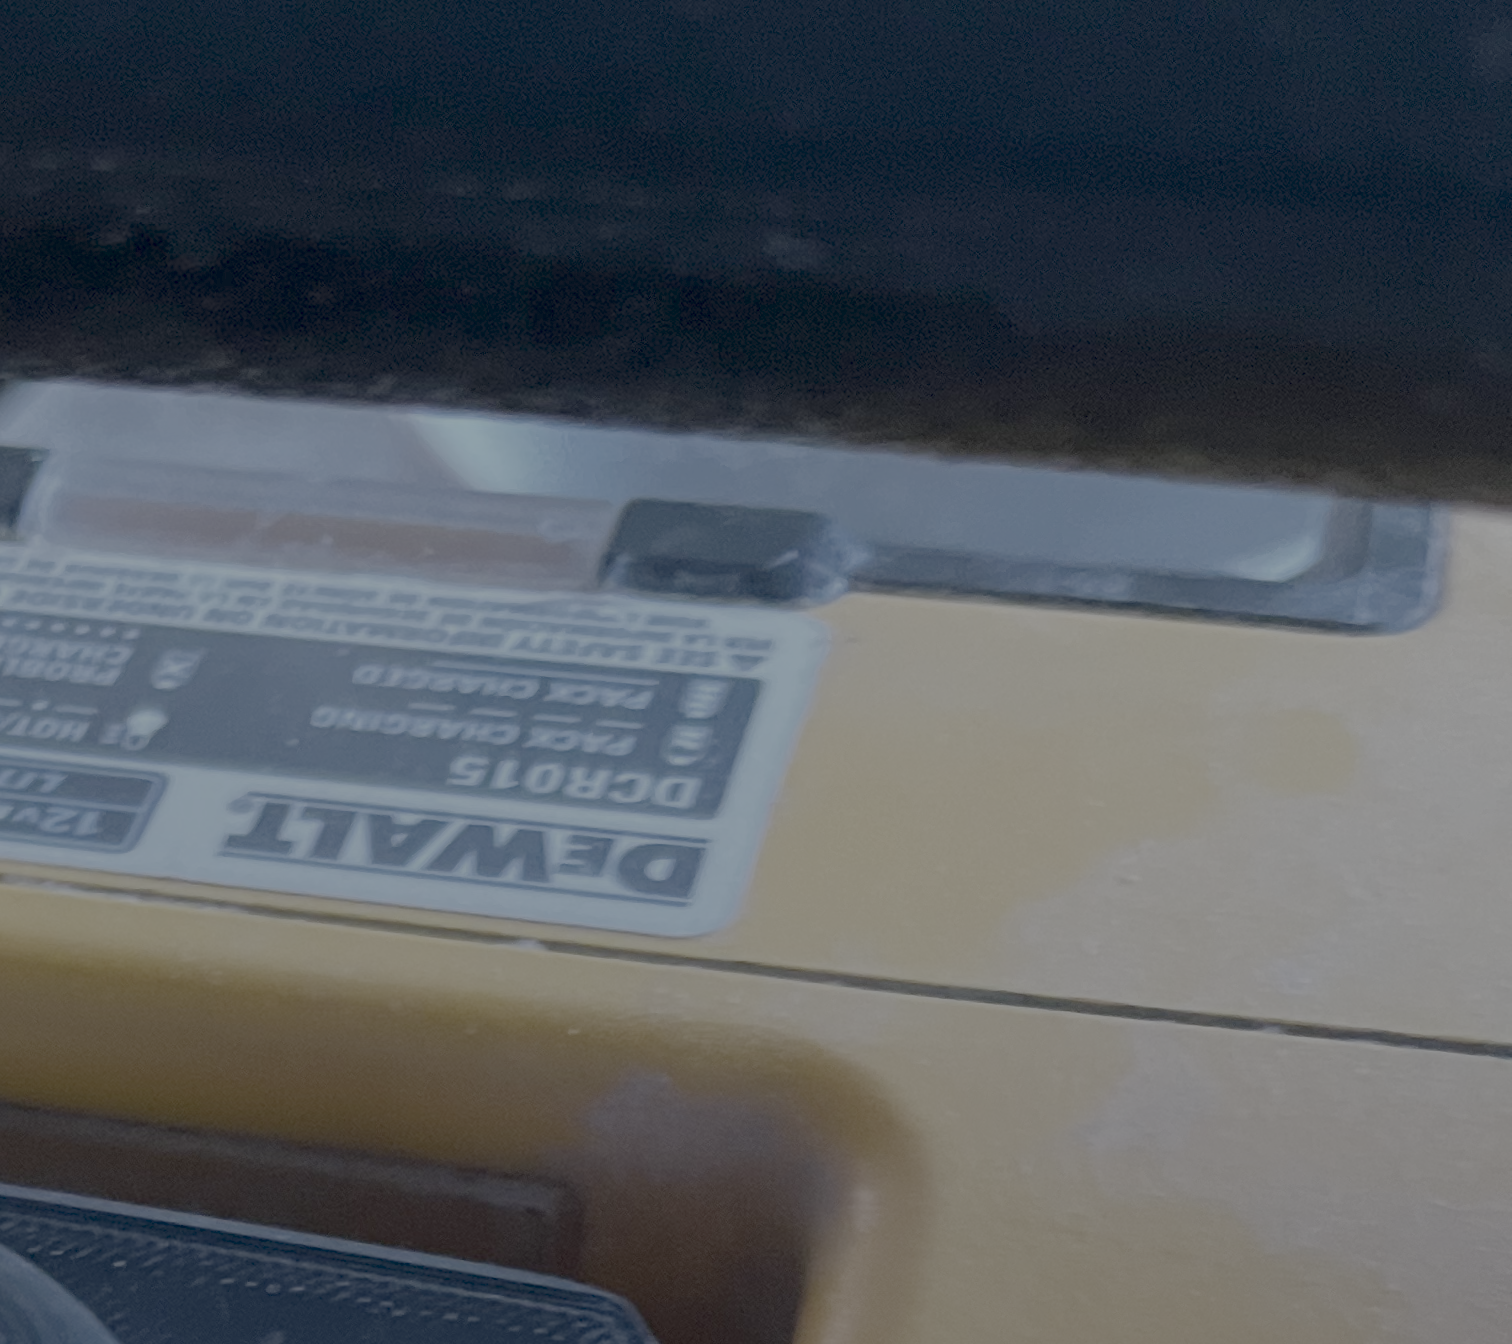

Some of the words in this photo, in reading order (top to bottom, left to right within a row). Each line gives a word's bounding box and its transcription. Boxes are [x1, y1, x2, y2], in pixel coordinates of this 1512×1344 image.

[351, 663, 539, 699] CHARGED
[543, 681, 654, 709] PACK
[310, 704, 520, 744] CHARGING
[522, 726, 636, 756] PACK
[445, 756, 700, 808] DCR015
[224, 803, 706, 898] DEWALT
